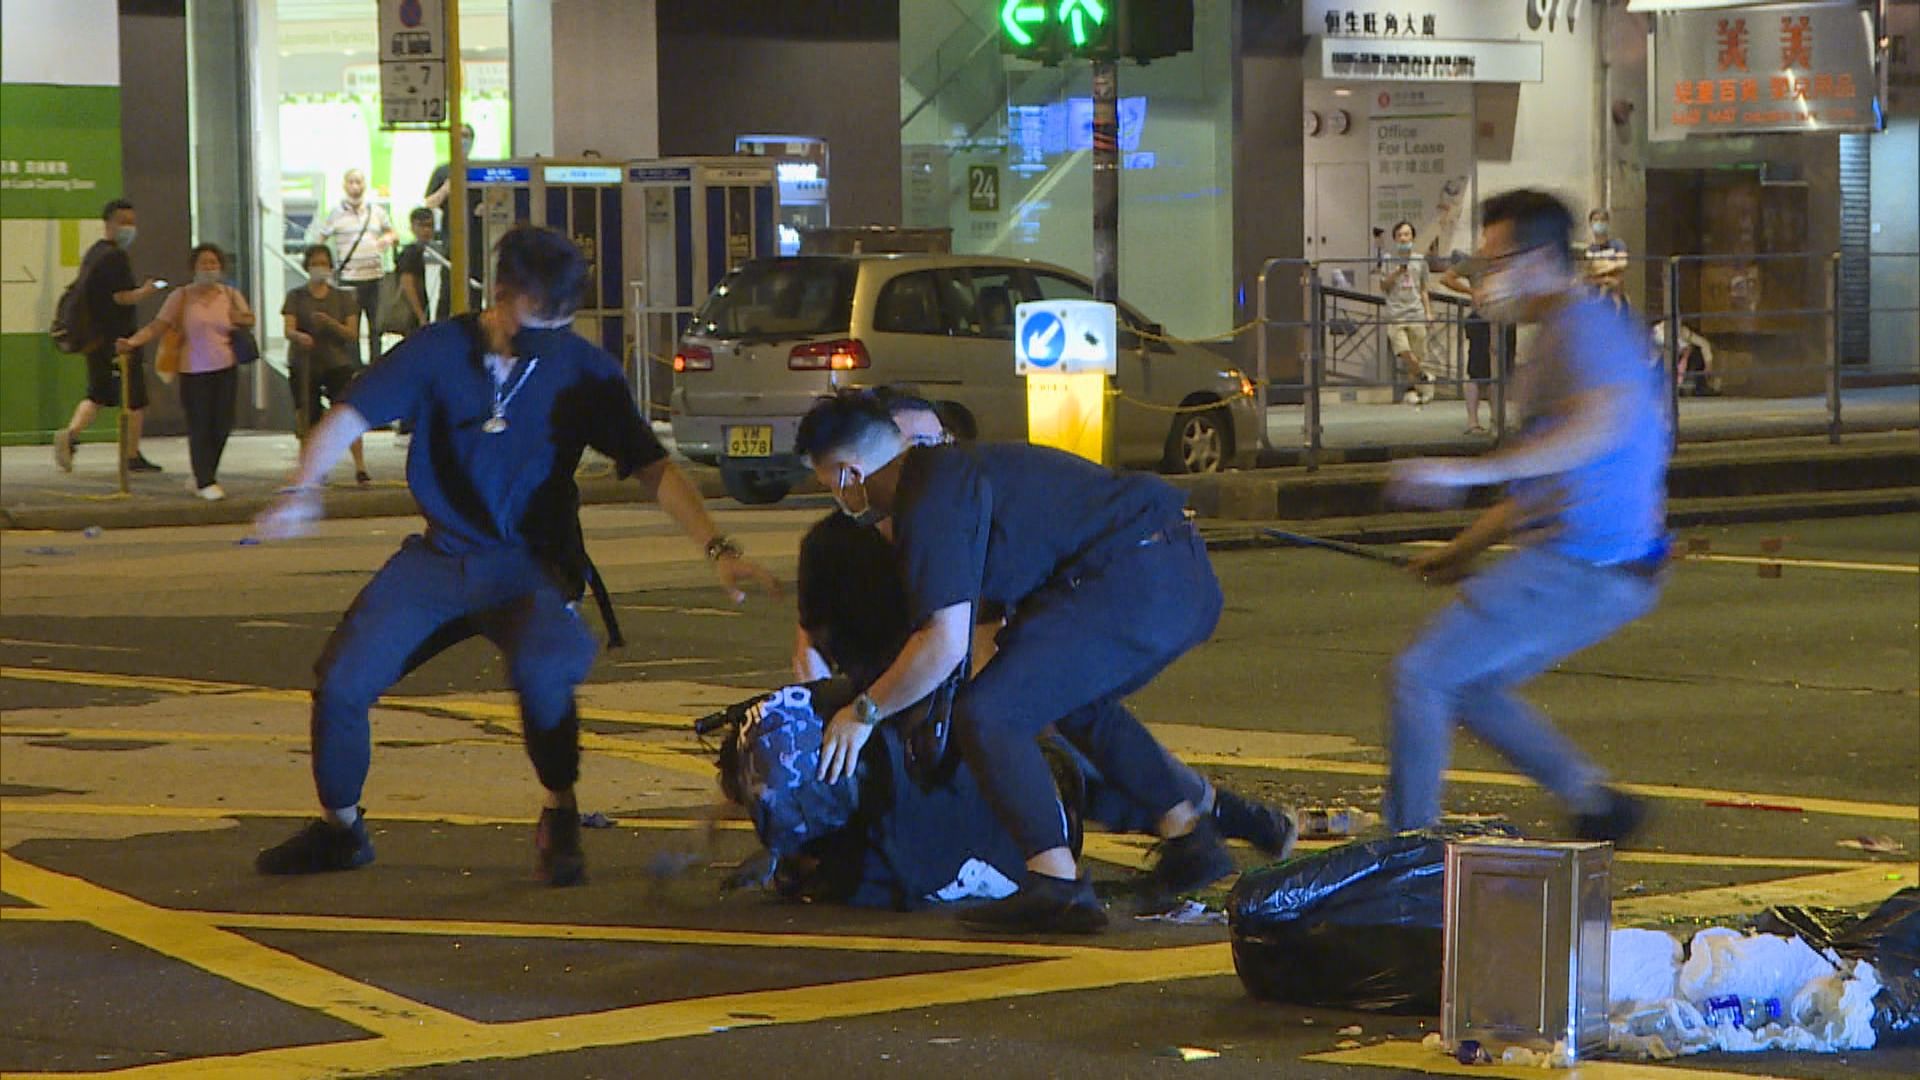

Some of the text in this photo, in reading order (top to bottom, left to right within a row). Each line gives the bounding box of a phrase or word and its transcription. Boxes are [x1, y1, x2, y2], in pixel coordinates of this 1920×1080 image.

[420, 65, 432, 86] 7
[422, 98, 441, 117] 12
[1378, 125, 1417, 139] Office
[1378, 142, 1445, 155] For Lease
[971, 168, 996, 208] 24
[732, 440, 768, 454] 9378
